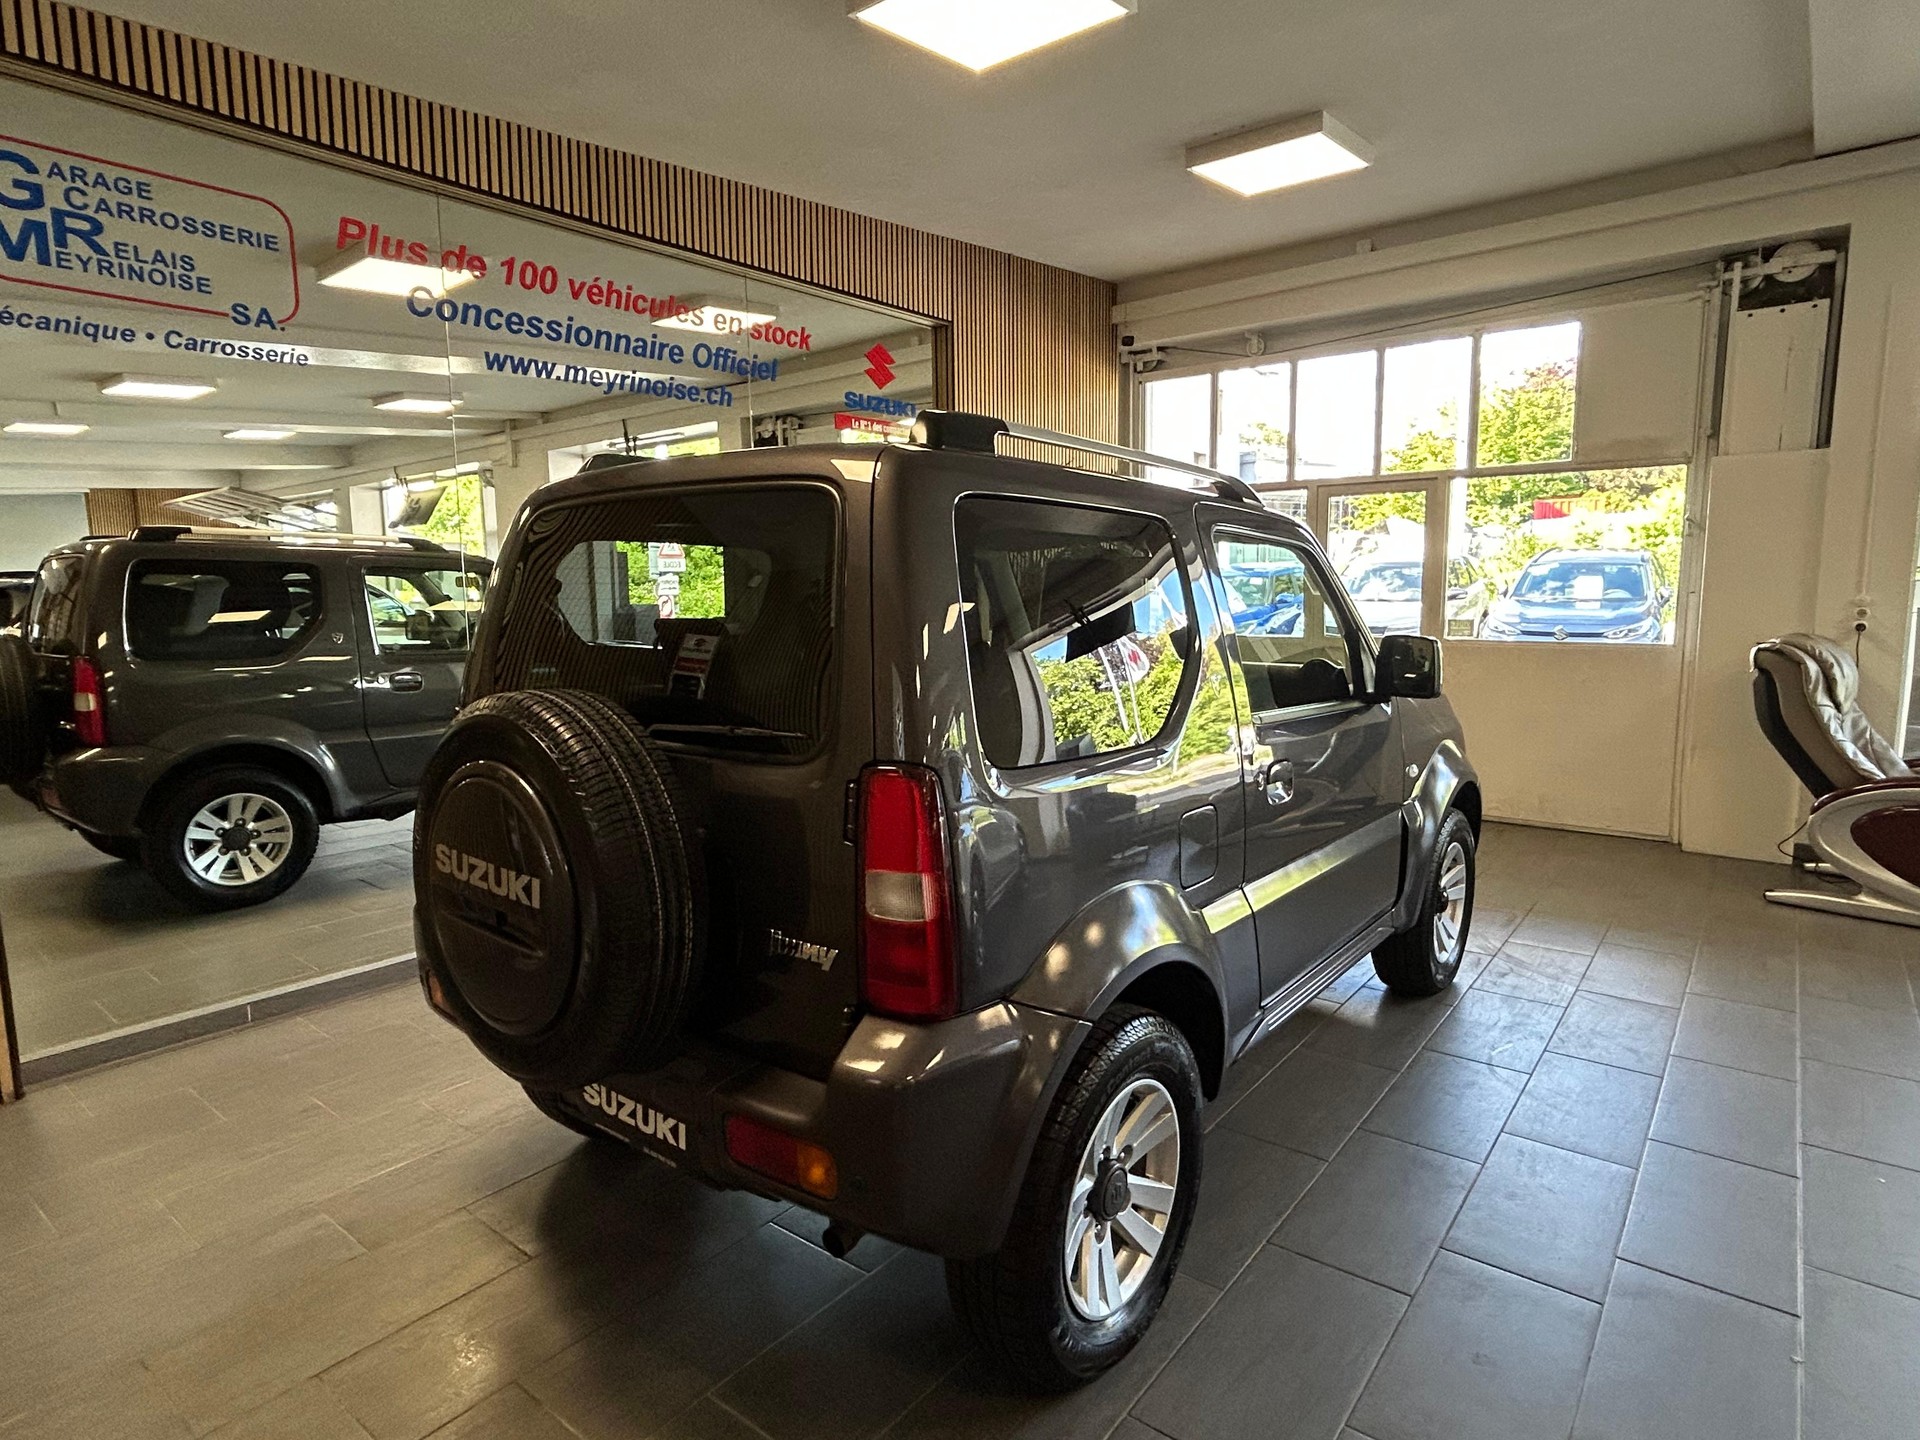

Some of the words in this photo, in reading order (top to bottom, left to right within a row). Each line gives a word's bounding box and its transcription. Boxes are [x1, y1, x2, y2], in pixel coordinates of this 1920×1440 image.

[49, 207, 197, 273] RELAIS
[62, 184, 281, 252] CARROSSERIE
[229, 301, 287, 332] SA.
[336, 216, 429, 266] Plus
[441, 244, 488, 279] de
[499, 256, 558, 295] 100
[567, 272, 705, 328] véhicules
[713, 311, 744, 336] en
[749, 317, 812, 351] stock
[0, 304, 137, 343] écanique
[163, 329, 310, 367] Carrosserie
[406, 285, 685, 365] Concessionnaire
[692, 341, 780, 382] Officiel
[483, 351, 733, 408] www.meyrinoise.ch
[844, 390, 917, 418] SUZUKI
[435, 843, 540, 909] SUZUKI
[582, 1082, 687, 1152] SUZUKI
